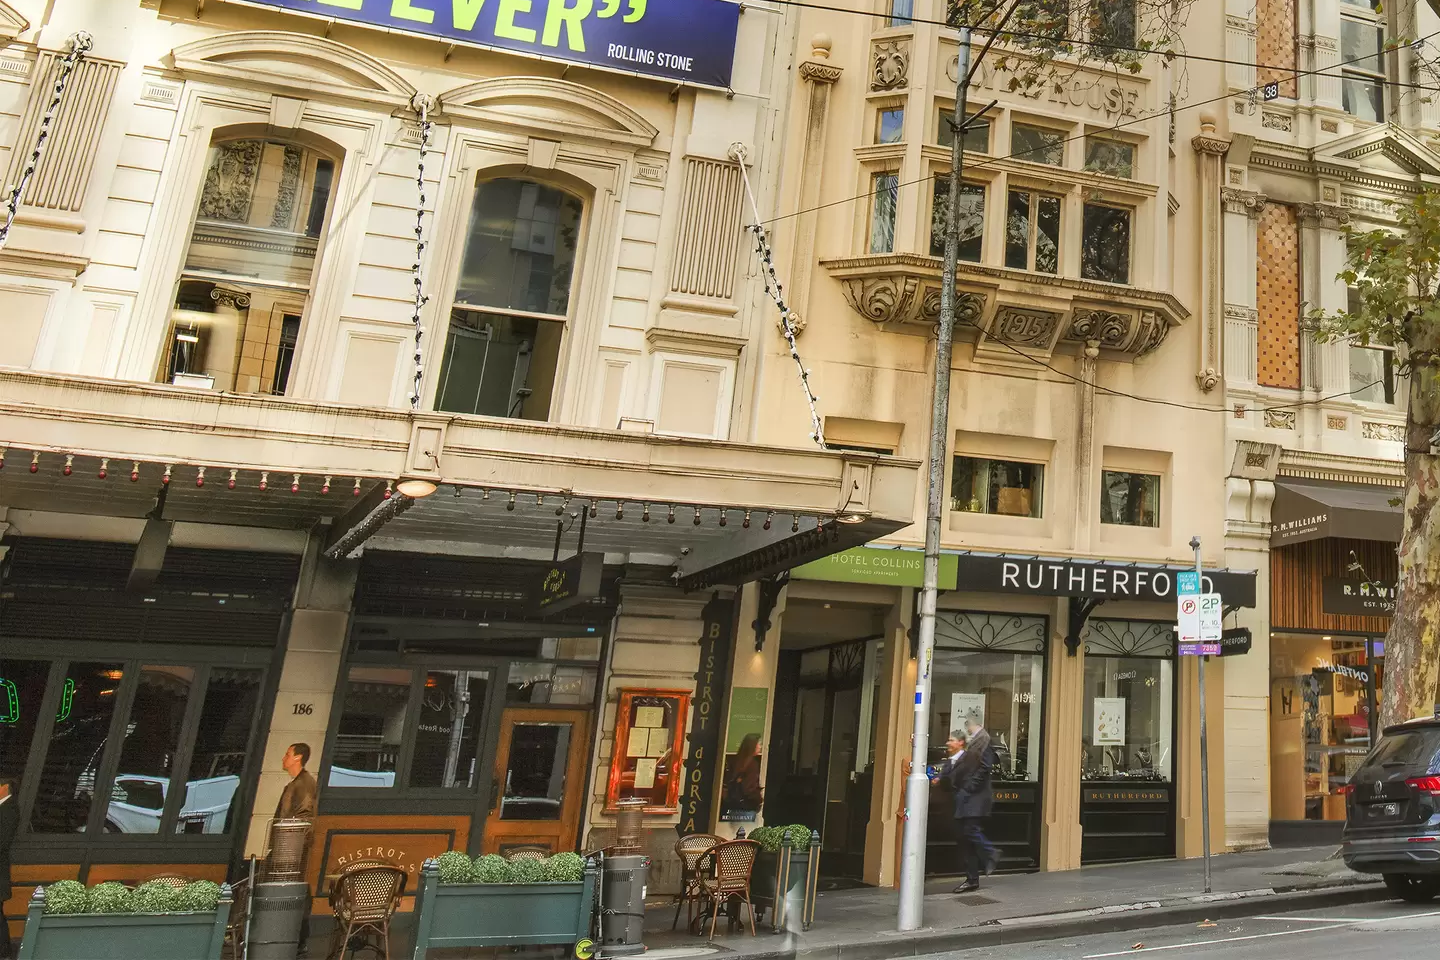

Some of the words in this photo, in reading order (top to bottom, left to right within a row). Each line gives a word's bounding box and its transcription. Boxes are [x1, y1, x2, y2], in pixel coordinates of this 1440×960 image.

[607, 43, 654, 66] ROLLING
[656, 51, 694, 73] STONE
[1265, 84, 1277, 99] 38
[1003, 313, 1043, 337] 1915
[831, 554, 868, 566] HOTEL
[872, 557, 921, 570] COLLINS
[1001, 562, 1214, 598] RUTHERFOD
[1202, 598, 1219, 609] 2P
[1223, 636, 1247, 645] THERFORD
[700, 622, 720, 730] BISTROT
[292, 703, 314, 716] 186
[684, 746, 704, 832] d'ORSA
[1091, 792, 1163, 800] RUTHERFORD
